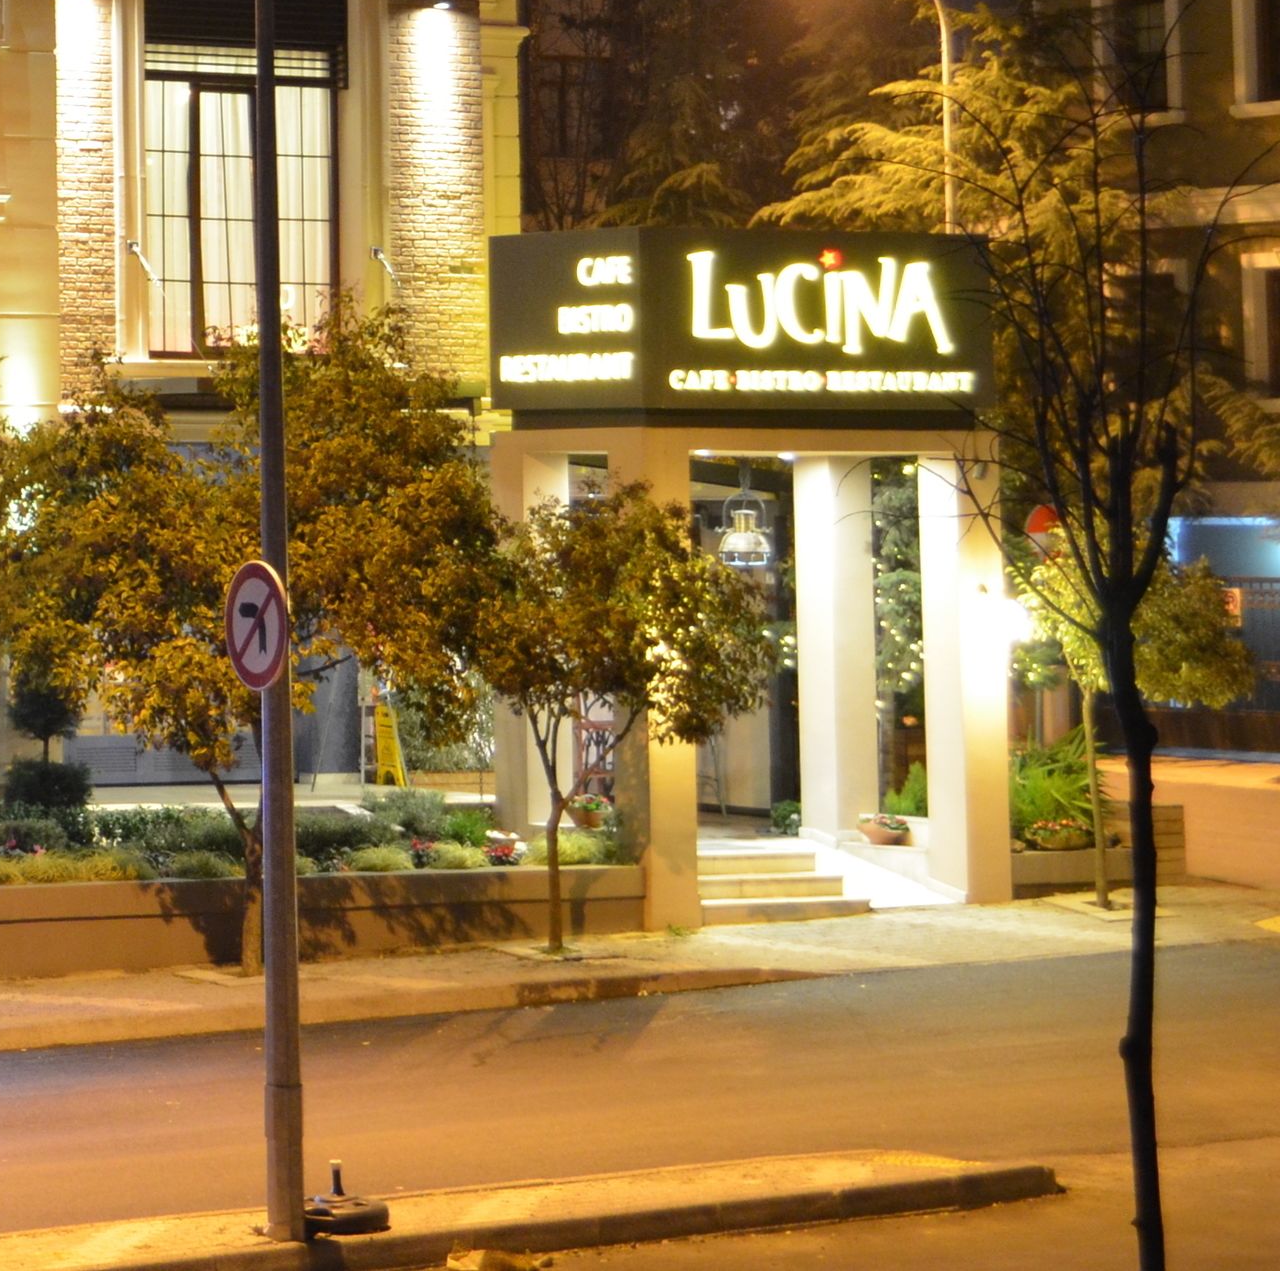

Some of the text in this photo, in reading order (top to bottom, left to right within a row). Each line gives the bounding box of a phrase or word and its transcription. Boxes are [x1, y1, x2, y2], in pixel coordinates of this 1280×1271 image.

[576, 255, 633, 286] CAFE
[557, 303, 635, 334] BISTRO
[500, 351, 635, 383] RESTAURANT
[668, 369, 975, 392] CAFE BISTRO RESTAURANT
